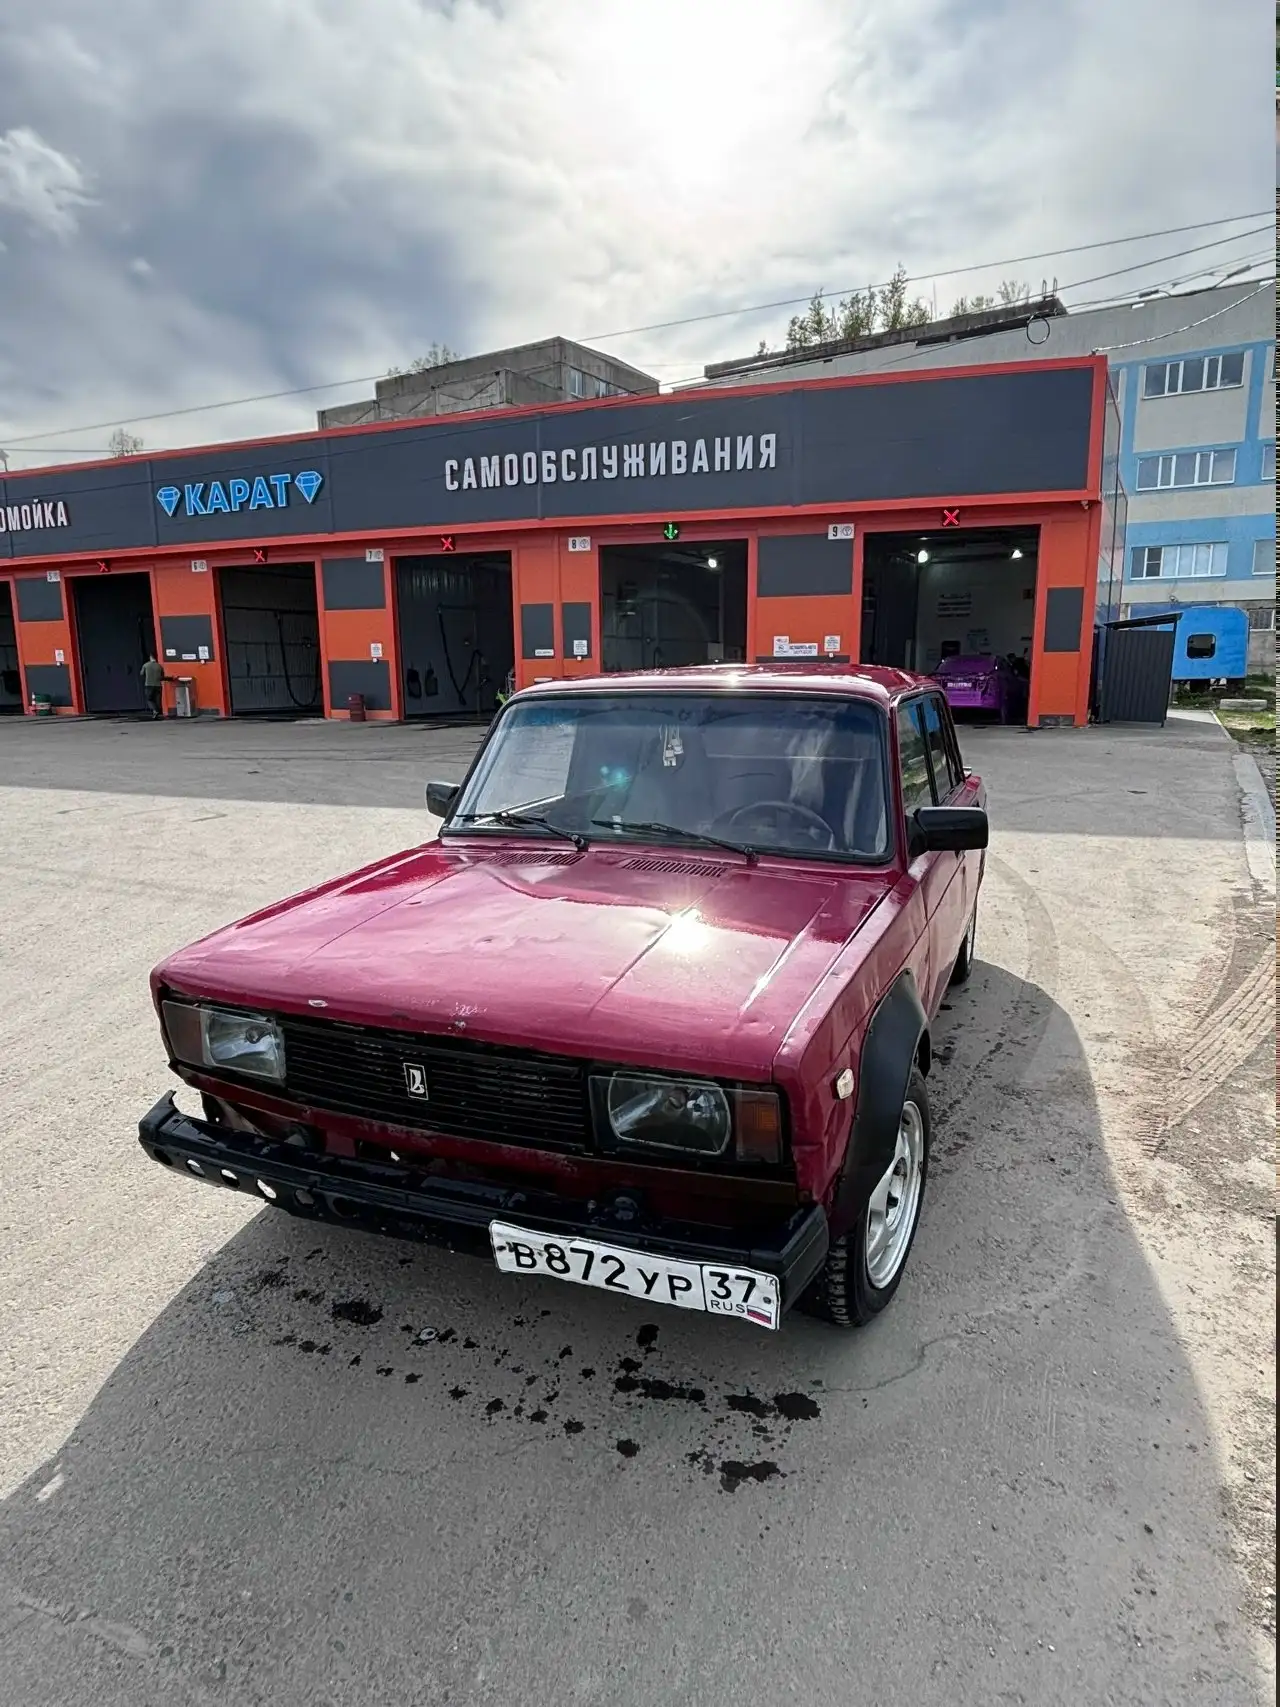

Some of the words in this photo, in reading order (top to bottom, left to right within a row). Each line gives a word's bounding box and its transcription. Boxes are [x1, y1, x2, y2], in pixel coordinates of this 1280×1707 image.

[445, 433, 776, 491] САМООБСЛУЖИВАНИЯ
[184, 473, 292, 516] КАРАТ
[571, 538, 577, 550] 8
[832, 525, 838, 538] 9
[512, 1242, 692, 1301] В872УР
[709, 1270, 757, 1303] 37
[710, 1299, 745, 1313] RUS
